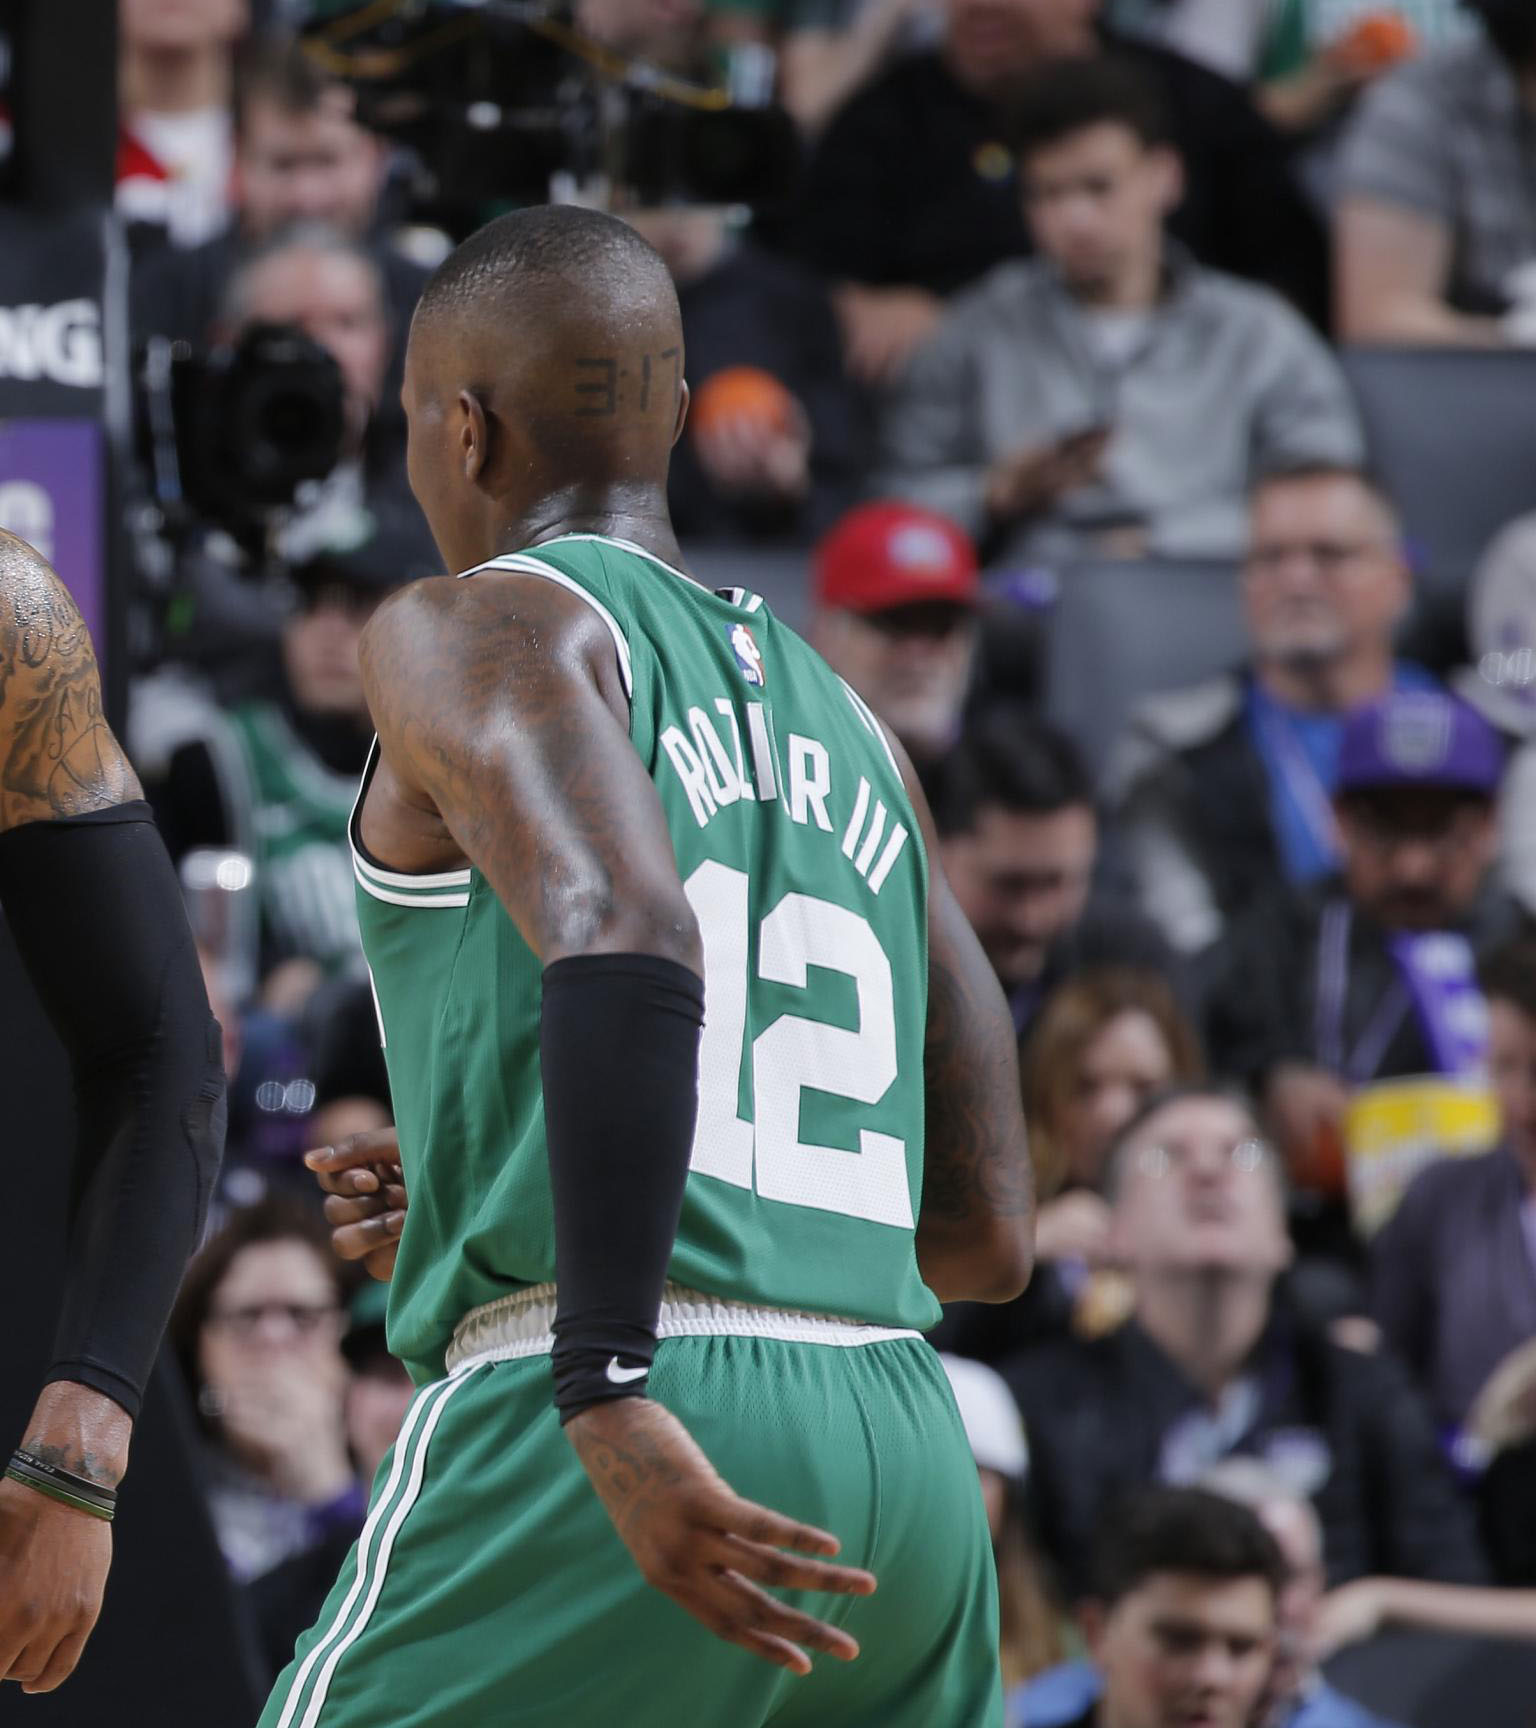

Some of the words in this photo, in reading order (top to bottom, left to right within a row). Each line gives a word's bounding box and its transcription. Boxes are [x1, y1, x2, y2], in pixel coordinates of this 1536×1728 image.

[575, 346, 681, 417] 3:17
[660, 697, 834, 833] ROZIR
[683, 858, 915, 1231] 12
